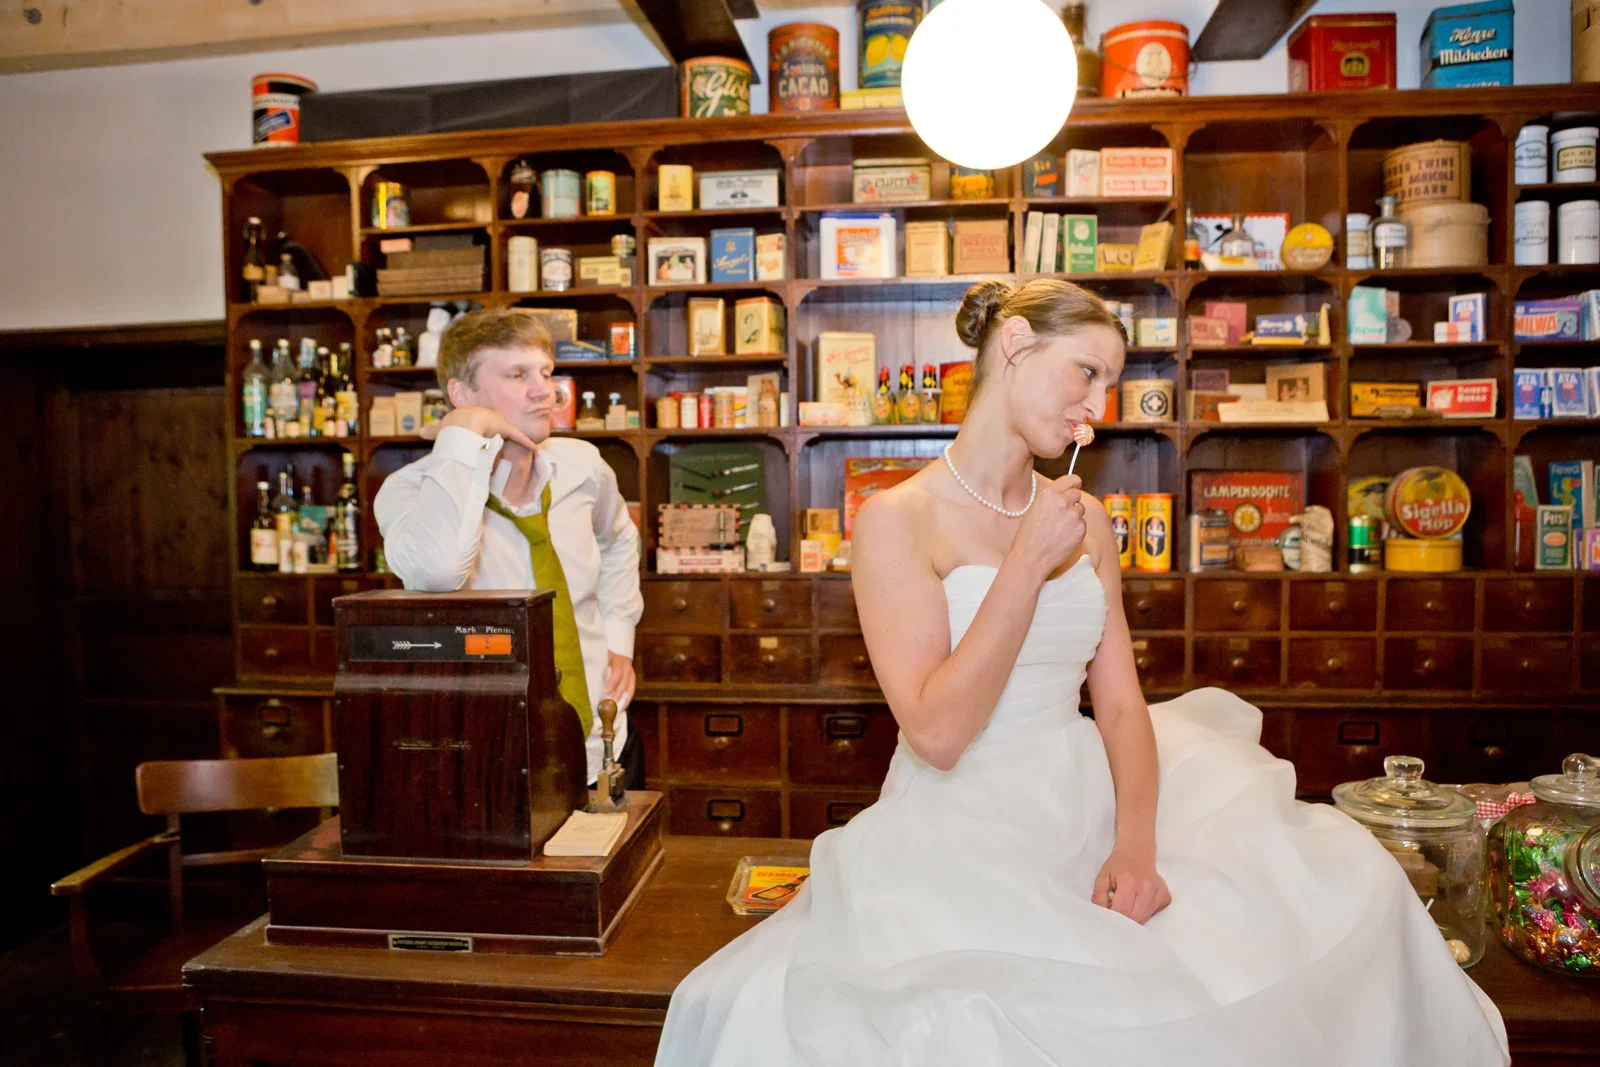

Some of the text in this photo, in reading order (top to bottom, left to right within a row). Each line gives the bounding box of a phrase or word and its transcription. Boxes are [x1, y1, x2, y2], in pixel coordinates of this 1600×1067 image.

[778, 75, 829, 98] CACAO
[1103, 247, 1135, 266] WO
[1419, 518, 1454, 531] Mop
[455, 626, 477, 634] Mark
